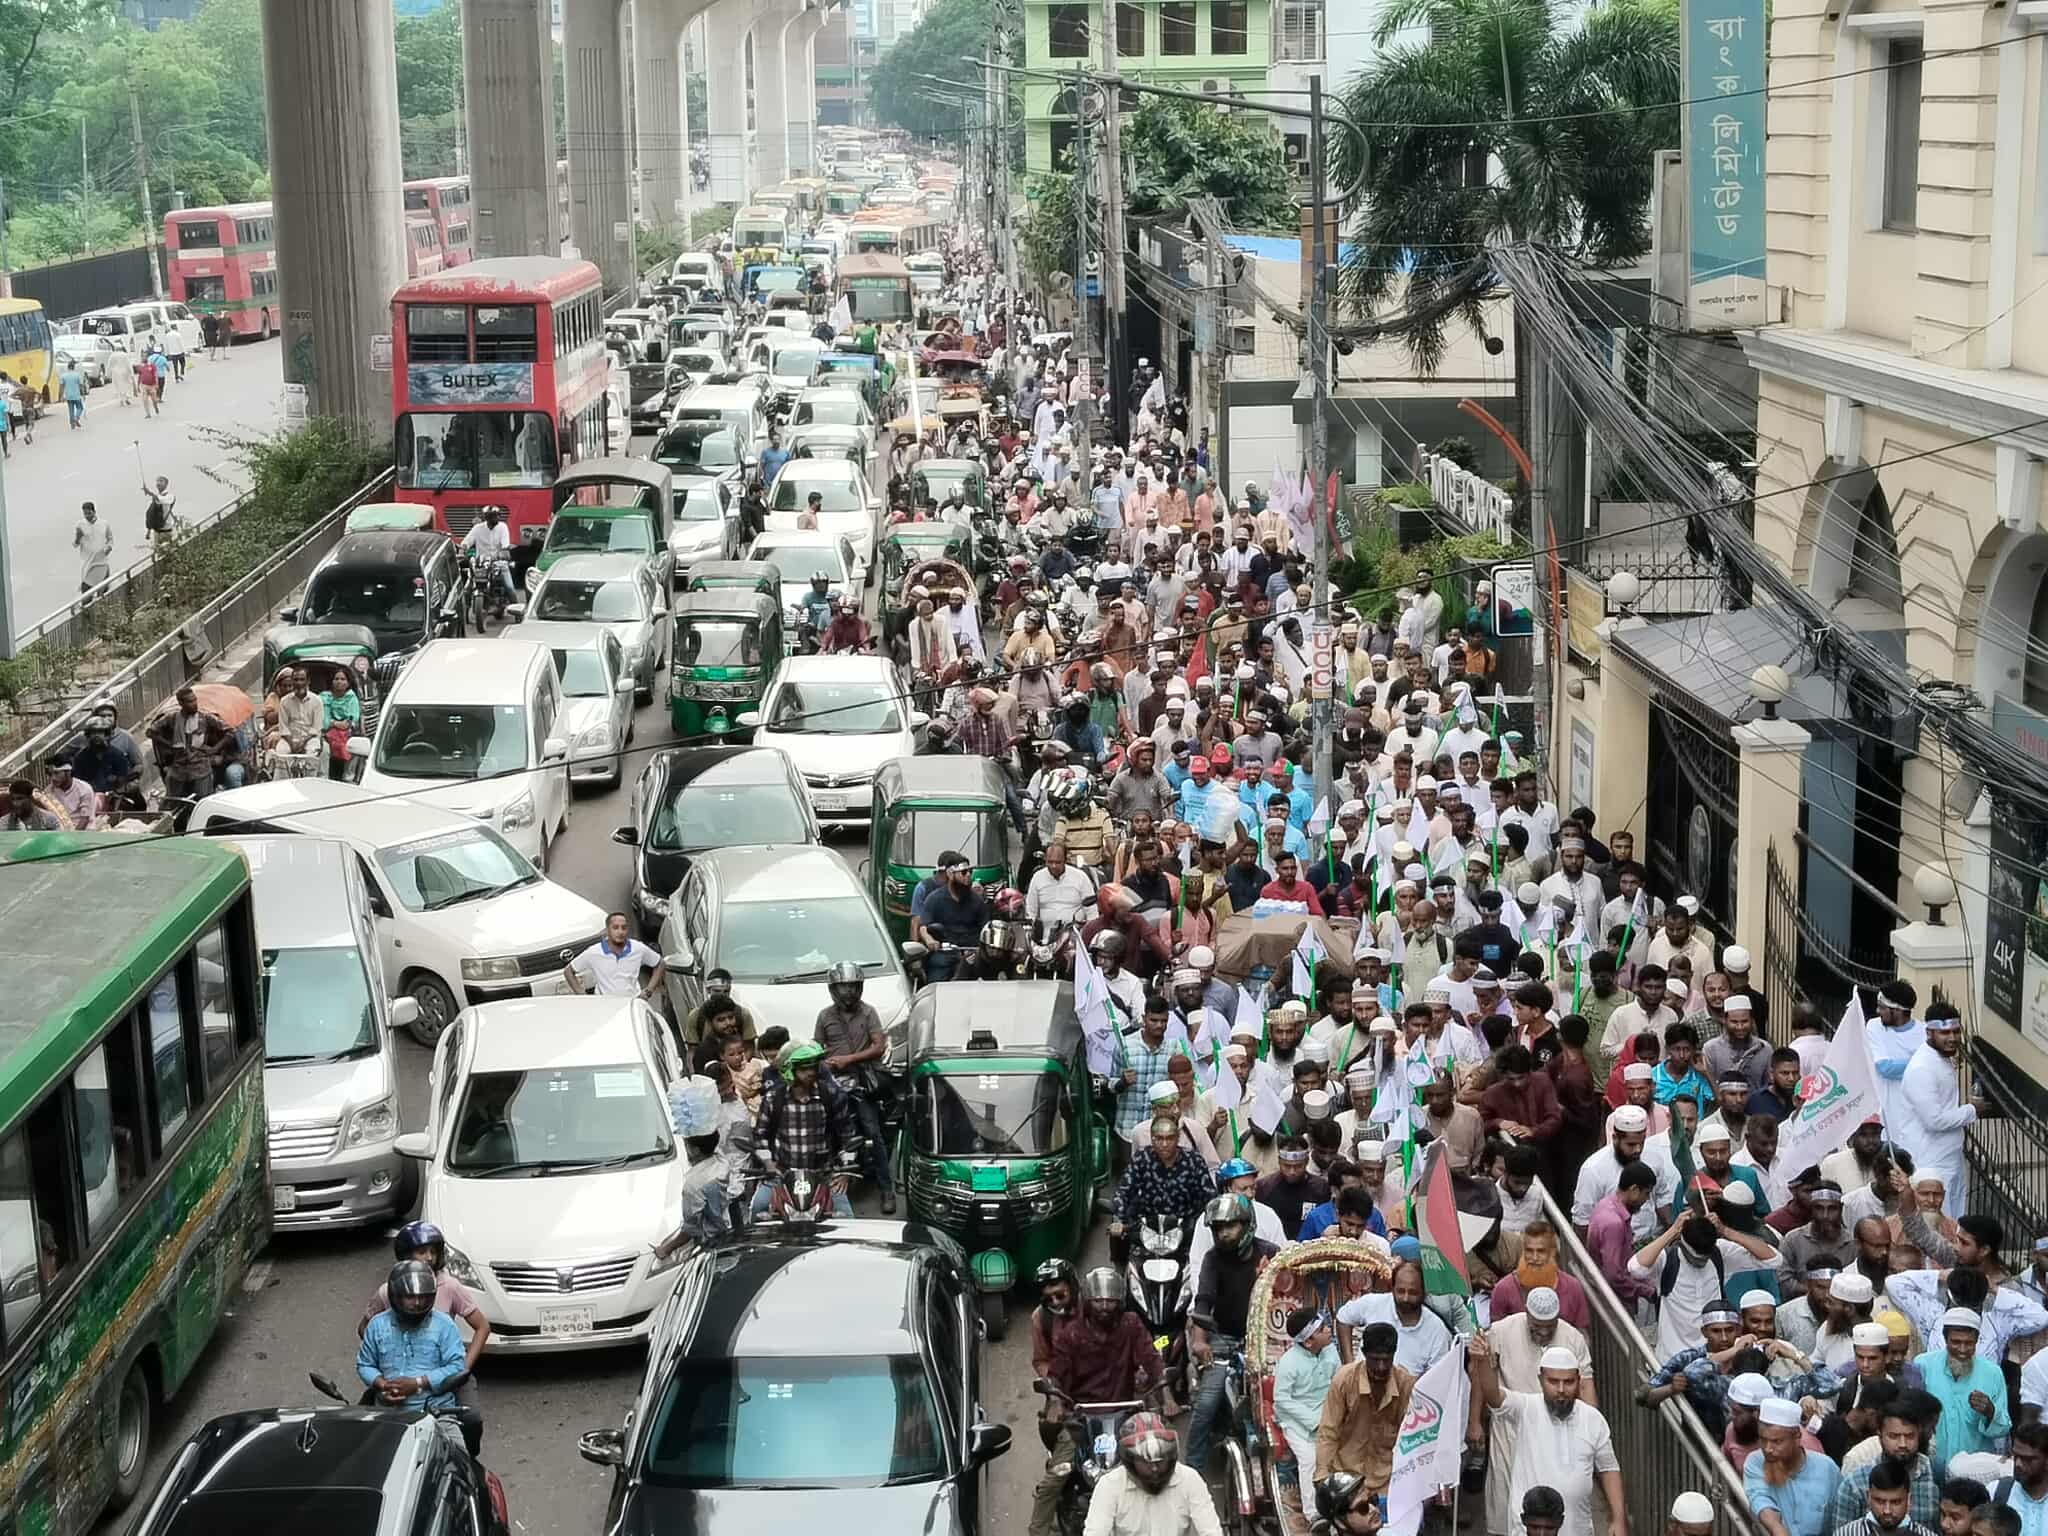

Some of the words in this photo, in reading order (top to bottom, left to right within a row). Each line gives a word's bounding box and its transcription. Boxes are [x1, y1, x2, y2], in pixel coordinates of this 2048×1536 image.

[1704, 16, 1746, 97] ব্যাংক
[1709, 114, 1745, 235] লিমিটেড
[442, 374, 497, 388] BUTEX
[1510, 583, 1530, 595] 24/7
[1313, 632, 1331, 686] UCC
[1993, 939, 2016, 976] 4K
